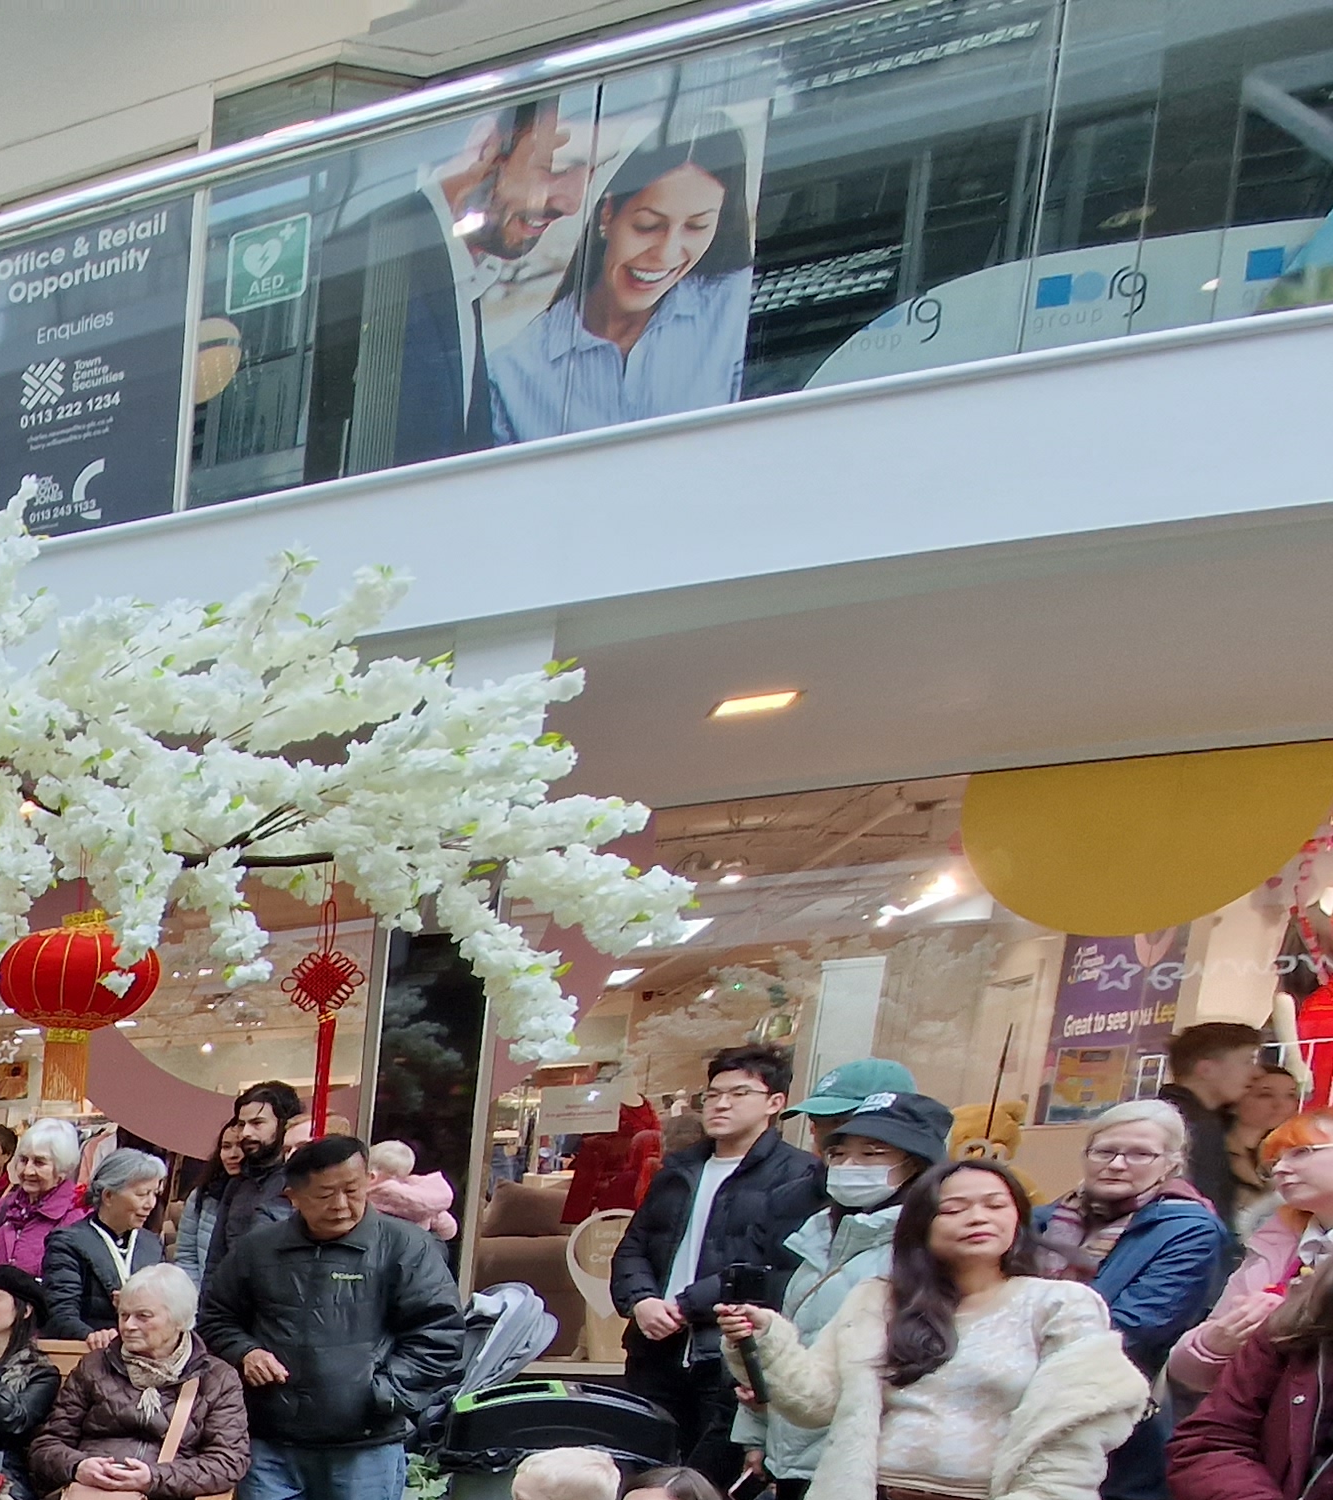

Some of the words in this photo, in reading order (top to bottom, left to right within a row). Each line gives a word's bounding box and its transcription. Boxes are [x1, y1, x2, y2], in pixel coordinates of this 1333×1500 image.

[72, 236, 90, 259] &
[98, 210, 167, 252] Retail
[8, 247, 151, 304] Opportunity
[248, 272, 285, 296] AED
[36, 311, 114, 345] Enquiries
[1035, 306, 1104, 333] group
[74, 356, 102, 371] Town
[72, 371, 125, 392] Securities
[20, 408, 53, 429] 0113
[56, 401, 82, 420] 222
[86, 391, 121, 412] 1234
[29, 509, 51, 524] 0113
[52, 504, 72, 519] 243
[73, 498, 96, 513] 1133
[1064, 1012, 1093, 1038] Great
[1093, 1012, 1105, 1033] to
[1106, 1011, 1128, 1032] see
[1154, 1001, 1177, 1024] Lee
